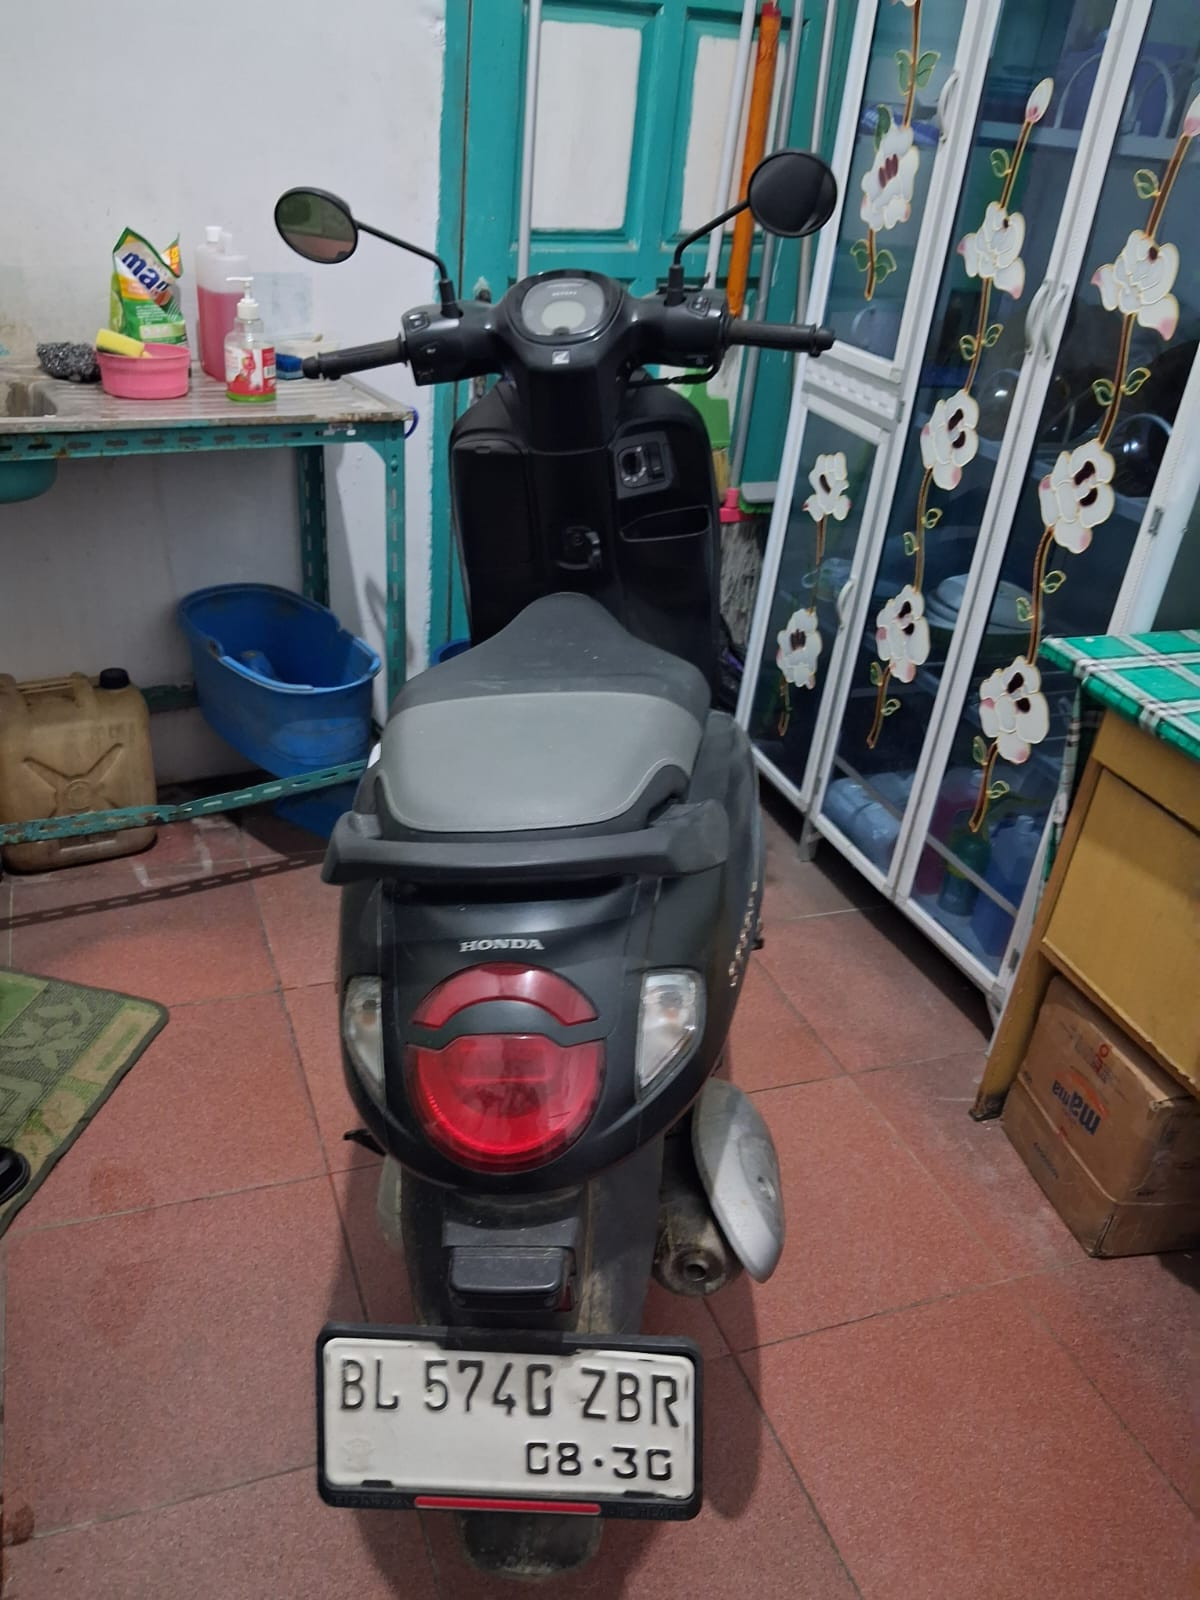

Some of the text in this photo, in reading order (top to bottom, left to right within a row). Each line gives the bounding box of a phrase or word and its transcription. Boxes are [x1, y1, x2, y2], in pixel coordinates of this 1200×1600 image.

[458, 938, 545, 953] HONDA
[339, 1358, 399, 1412] BL
[580, 1366, 680, 1428] ZBR
